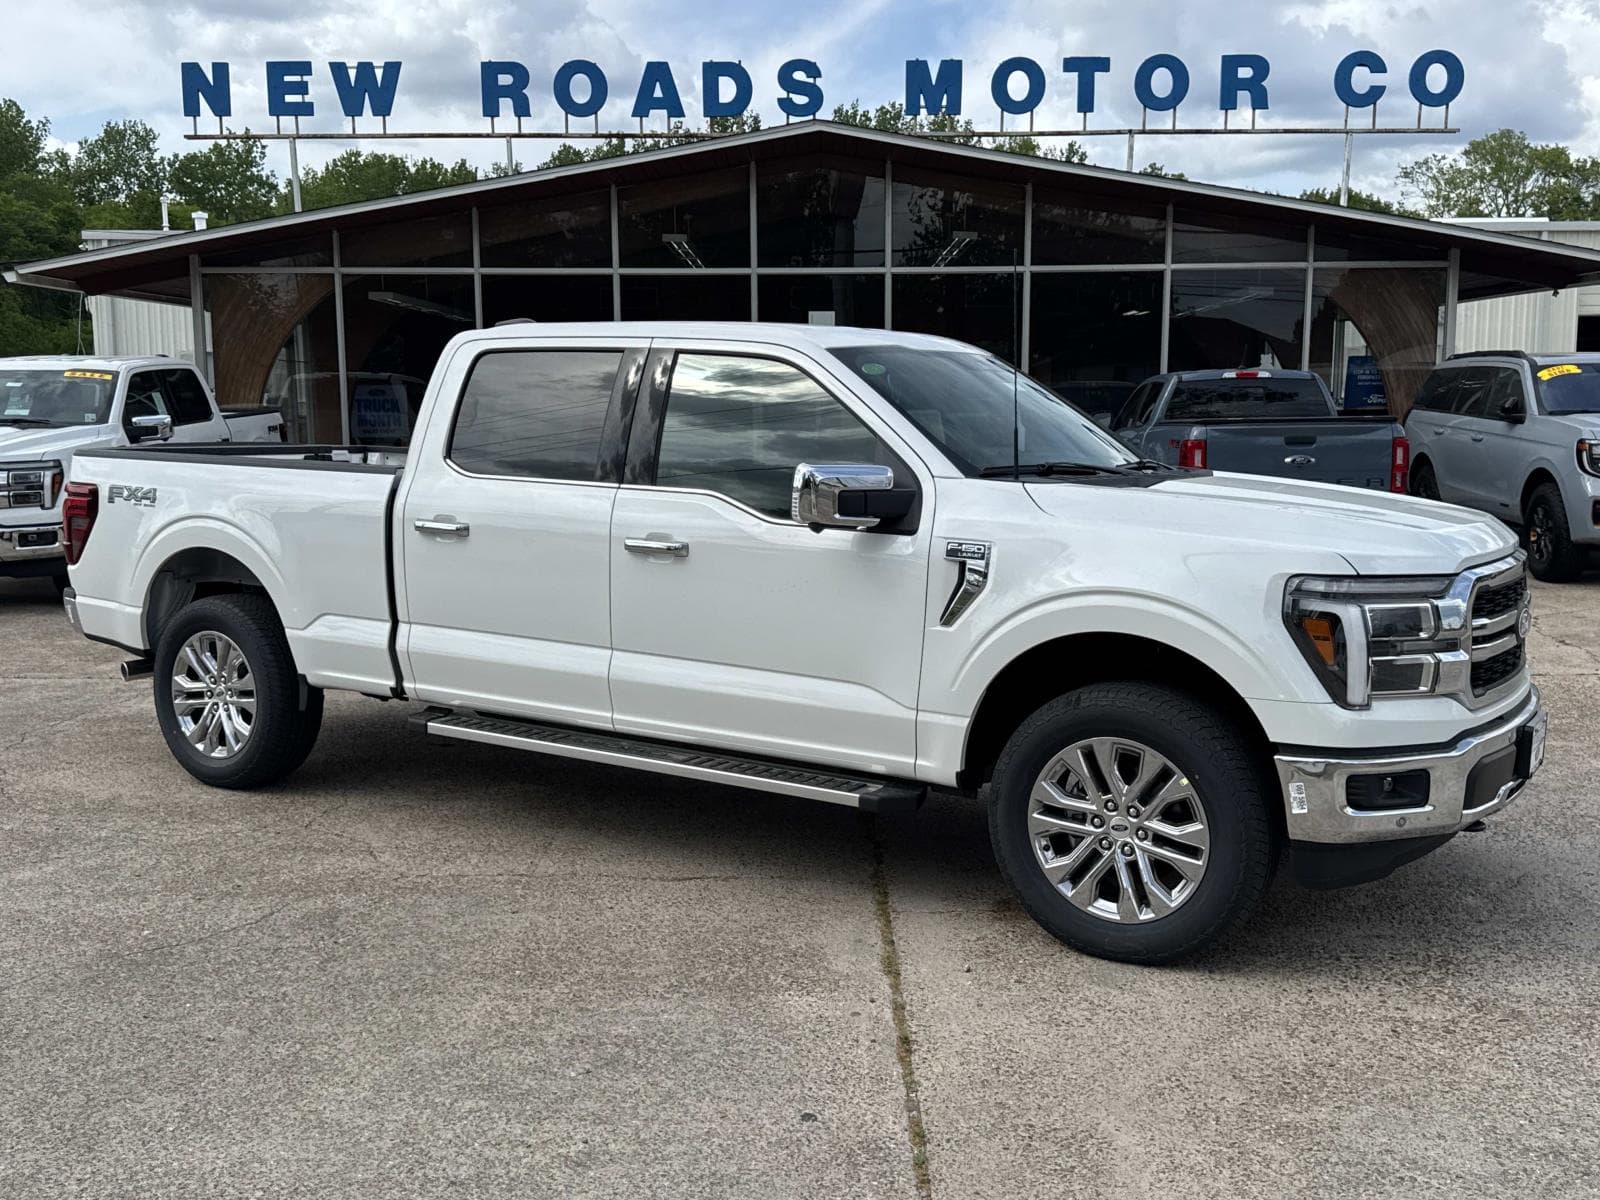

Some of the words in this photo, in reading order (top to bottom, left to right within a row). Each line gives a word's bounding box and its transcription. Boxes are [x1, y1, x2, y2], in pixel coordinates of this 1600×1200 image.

[182, 61, 400, 117] NEW
[481, 59, 823, 119] ROADS
[906, 53, 1270, 115] MOTOR
[1334, 50, 1464, 108] CO
[355, 397, 401, 413] TRUCK
[107, 484, 157, 504] FX4
[947, 543, 985, 553] F-150
